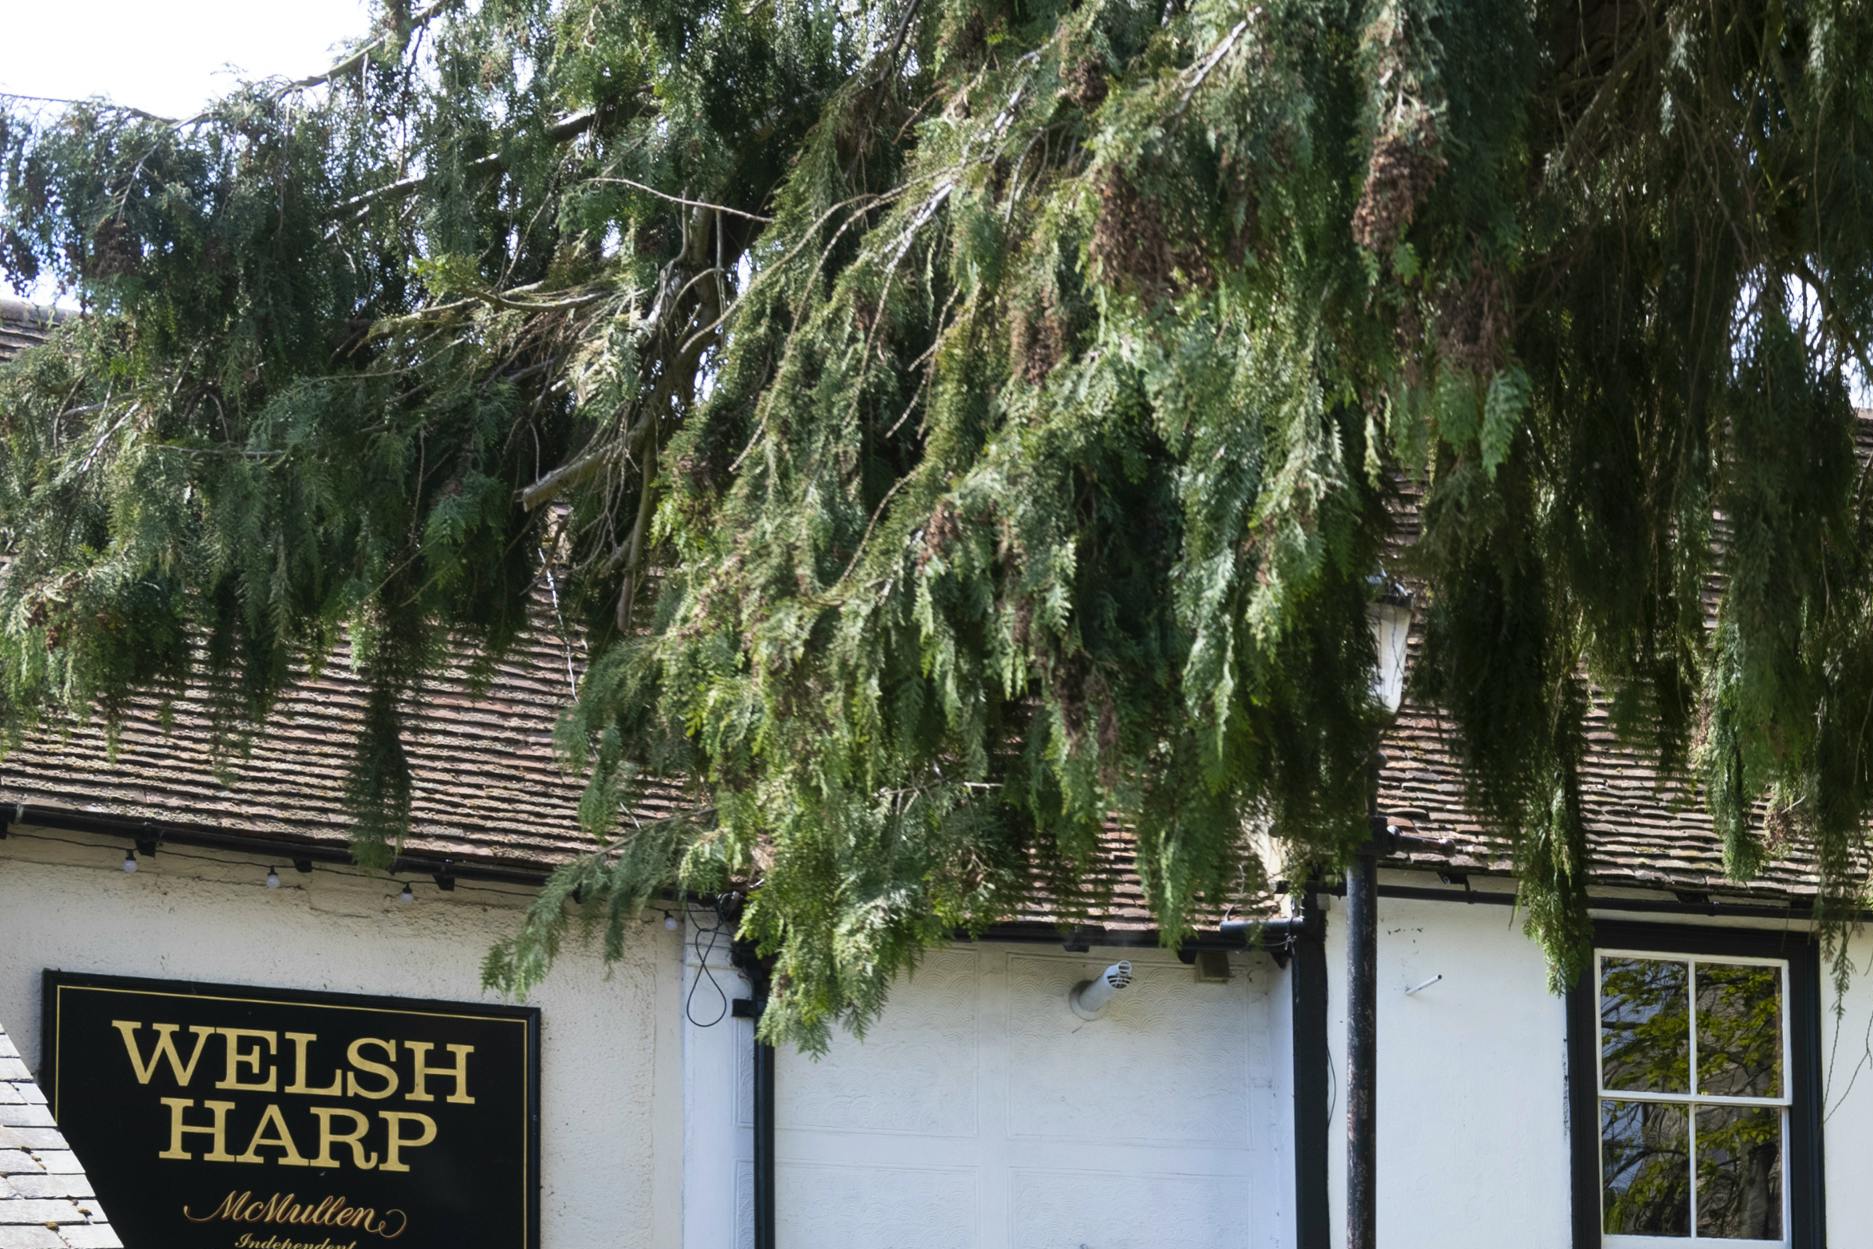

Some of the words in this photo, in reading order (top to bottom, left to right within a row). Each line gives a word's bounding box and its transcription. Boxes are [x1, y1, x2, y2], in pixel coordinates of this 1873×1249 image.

[111, 1020, 476, 1104] WELSH
[159, 1097, 438, 1172] HARP
[184, 1190, 407, 1239] McMullen
